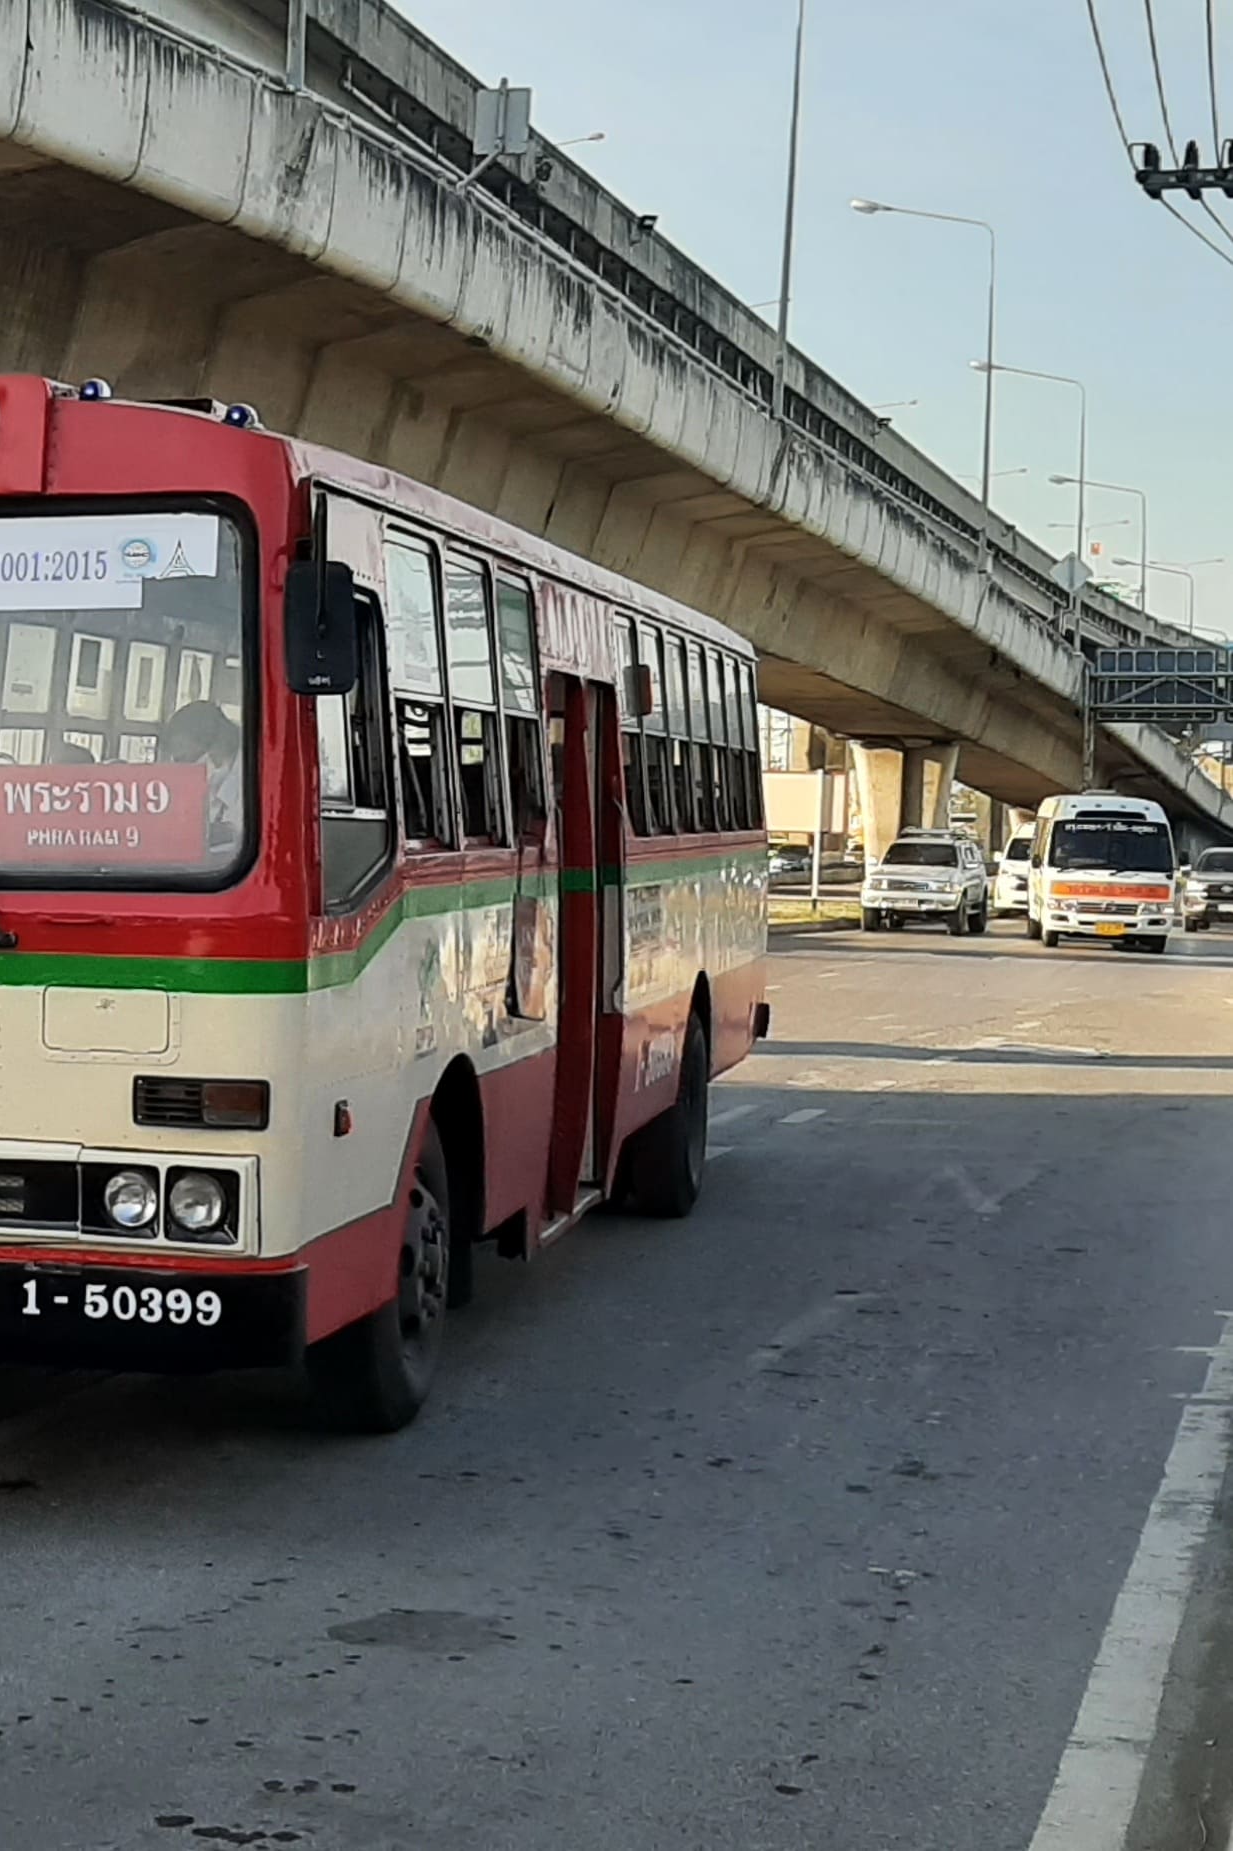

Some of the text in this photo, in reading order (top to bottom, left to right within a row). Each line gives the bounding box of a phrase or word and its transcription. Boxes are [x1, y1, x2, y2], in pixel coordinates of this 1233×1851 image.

[3, 780, 139, 814] พระราม
[125, 825, 140, 849] 9
[83, 1283, 223, 1326] 50399
